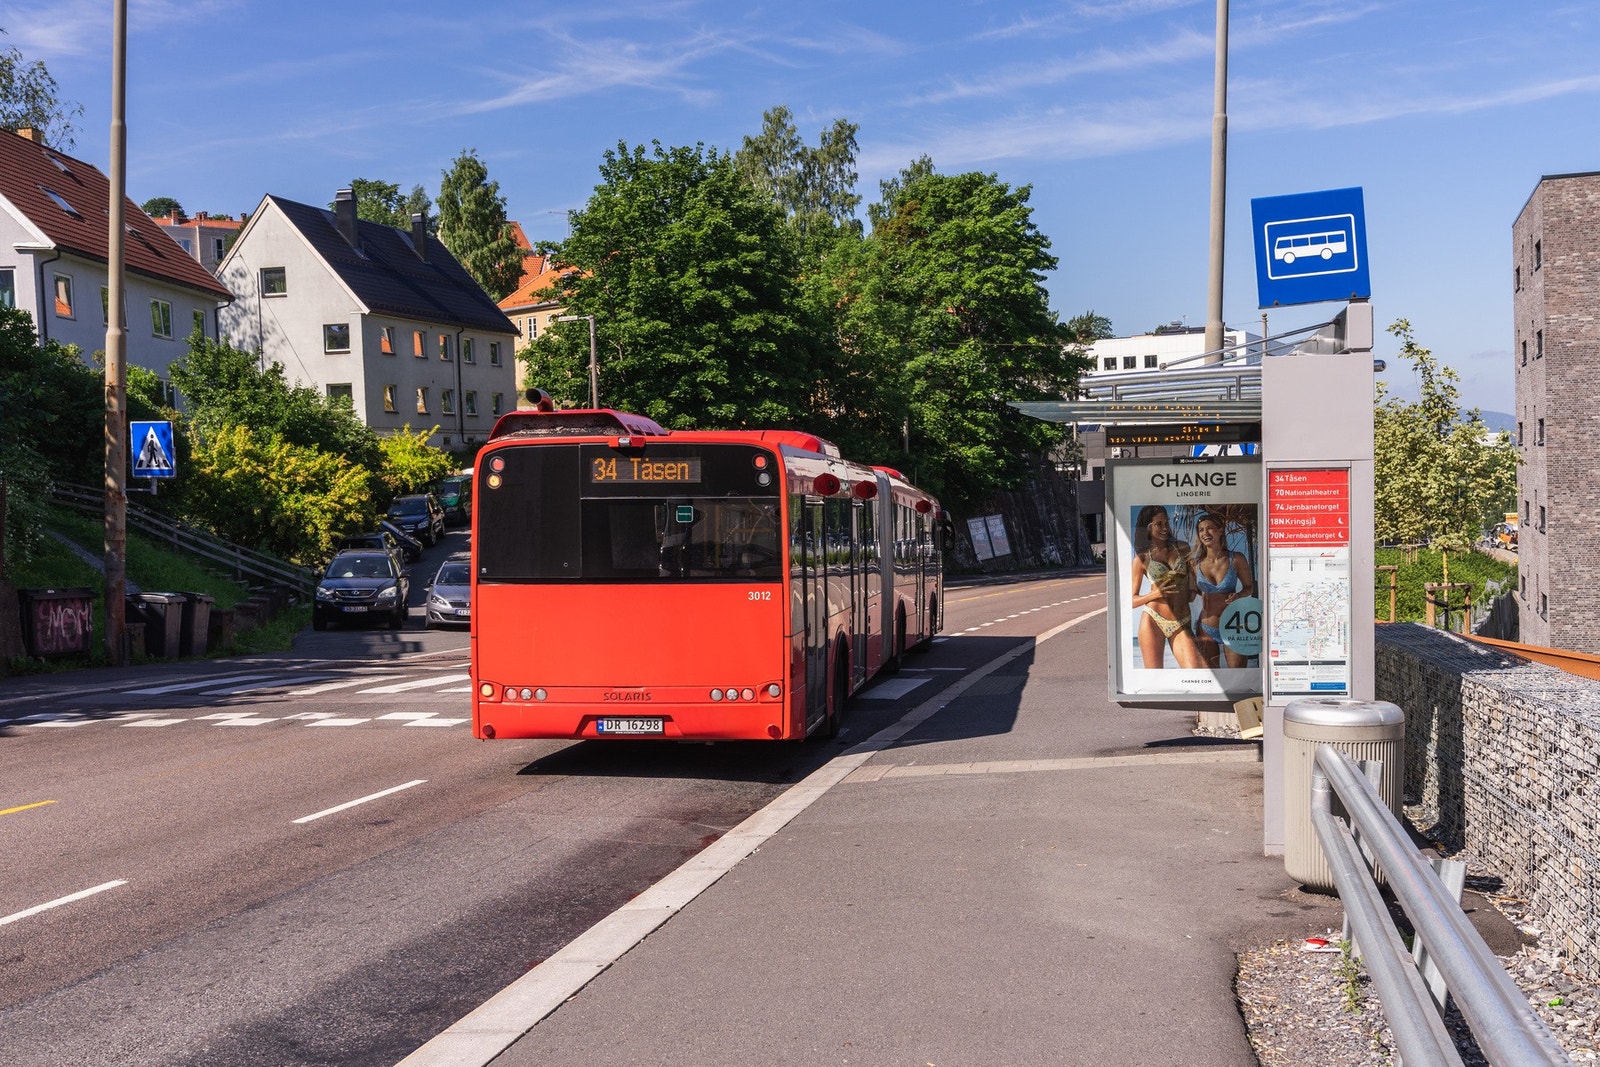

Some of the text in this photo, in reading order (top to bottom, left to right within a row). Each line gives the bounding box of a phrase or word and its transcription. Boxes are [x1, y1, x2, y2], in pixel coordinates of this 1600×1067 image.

[594, 457, 689, 481] 34 Tåsen
[1151, 472, 1237, 487] CHANGE
[1285, 474, 1307, 482] Tåsen
[1285, 503, 1340, 512] Jernbanetorget
[1285, 517, 1316, 526] Kringsjå
[1285, 532, 1336, 540] Jernbanetorget
[748, 591, 771, 601] 3012
[603, 692, 652, 702] SOLARIS
[606, 719, 660, 730] DR 16298
